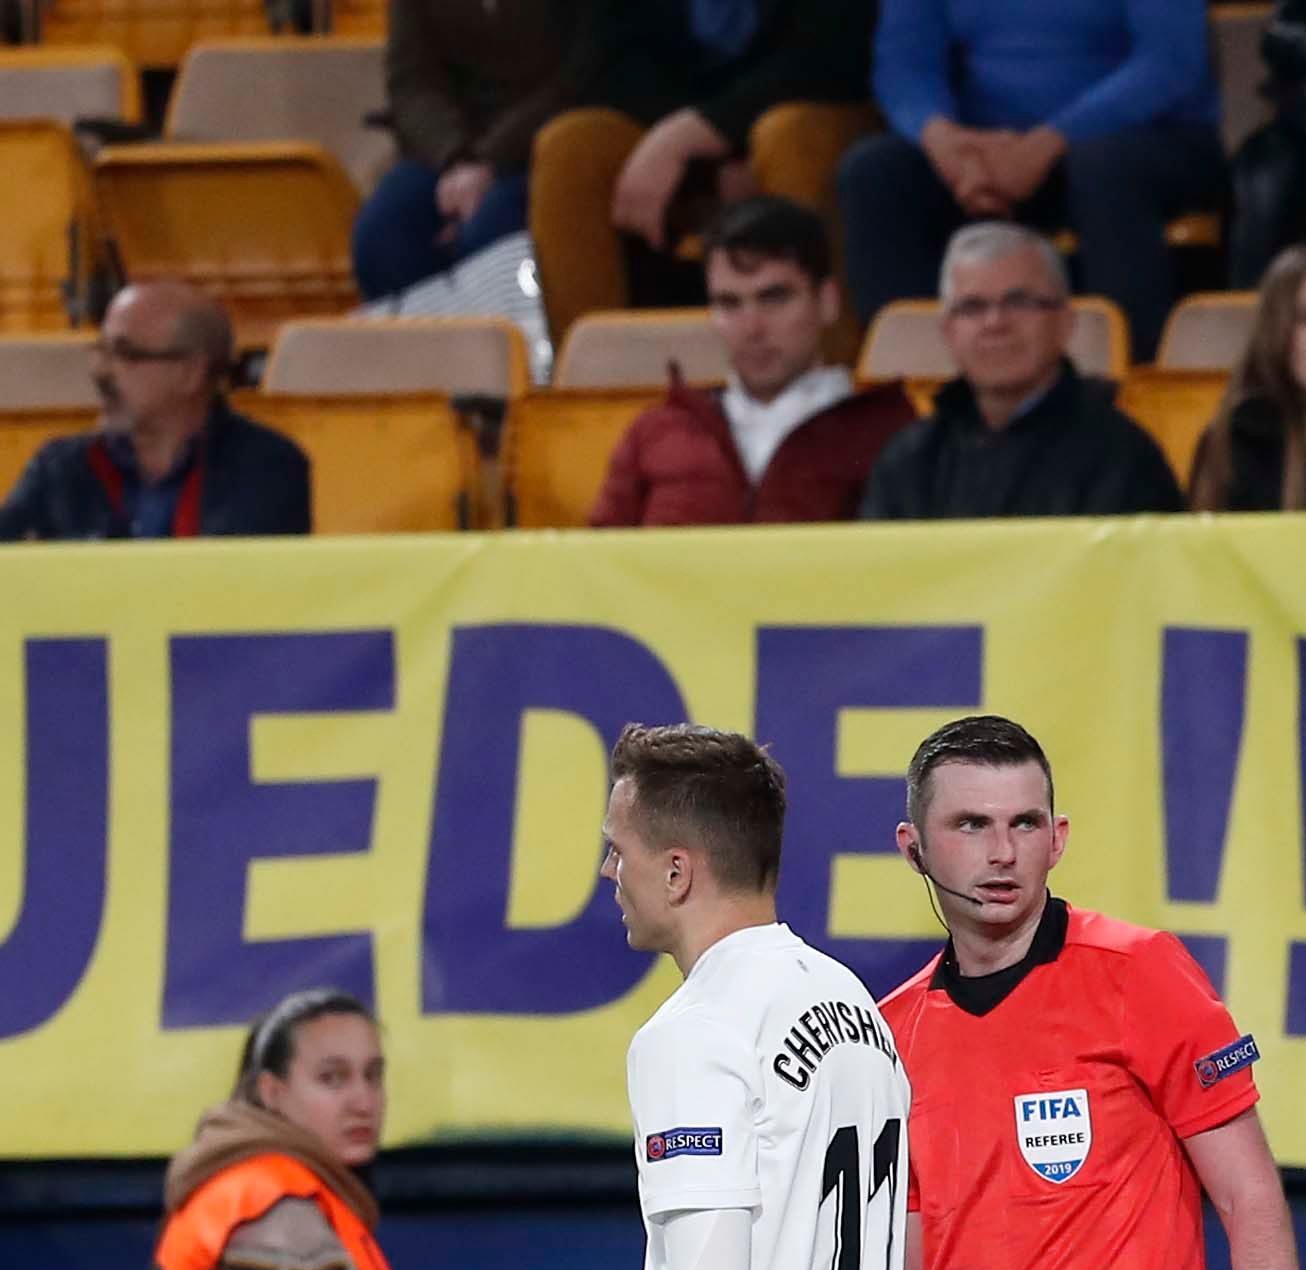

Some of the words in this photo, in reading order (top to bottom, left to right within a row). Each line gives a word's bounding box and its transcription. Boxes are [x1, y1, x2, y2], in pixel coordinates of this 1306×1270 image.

[1215, 1041, 1257, 1072] RESPECT
[1022, 1097, 1081, 1122] FIFA
[665, 1134, 721, 1151] RESPECT
[1025, 1132, 1085, 1148] REFEREE
[1044, 1162, 1072, 1176] 2019
